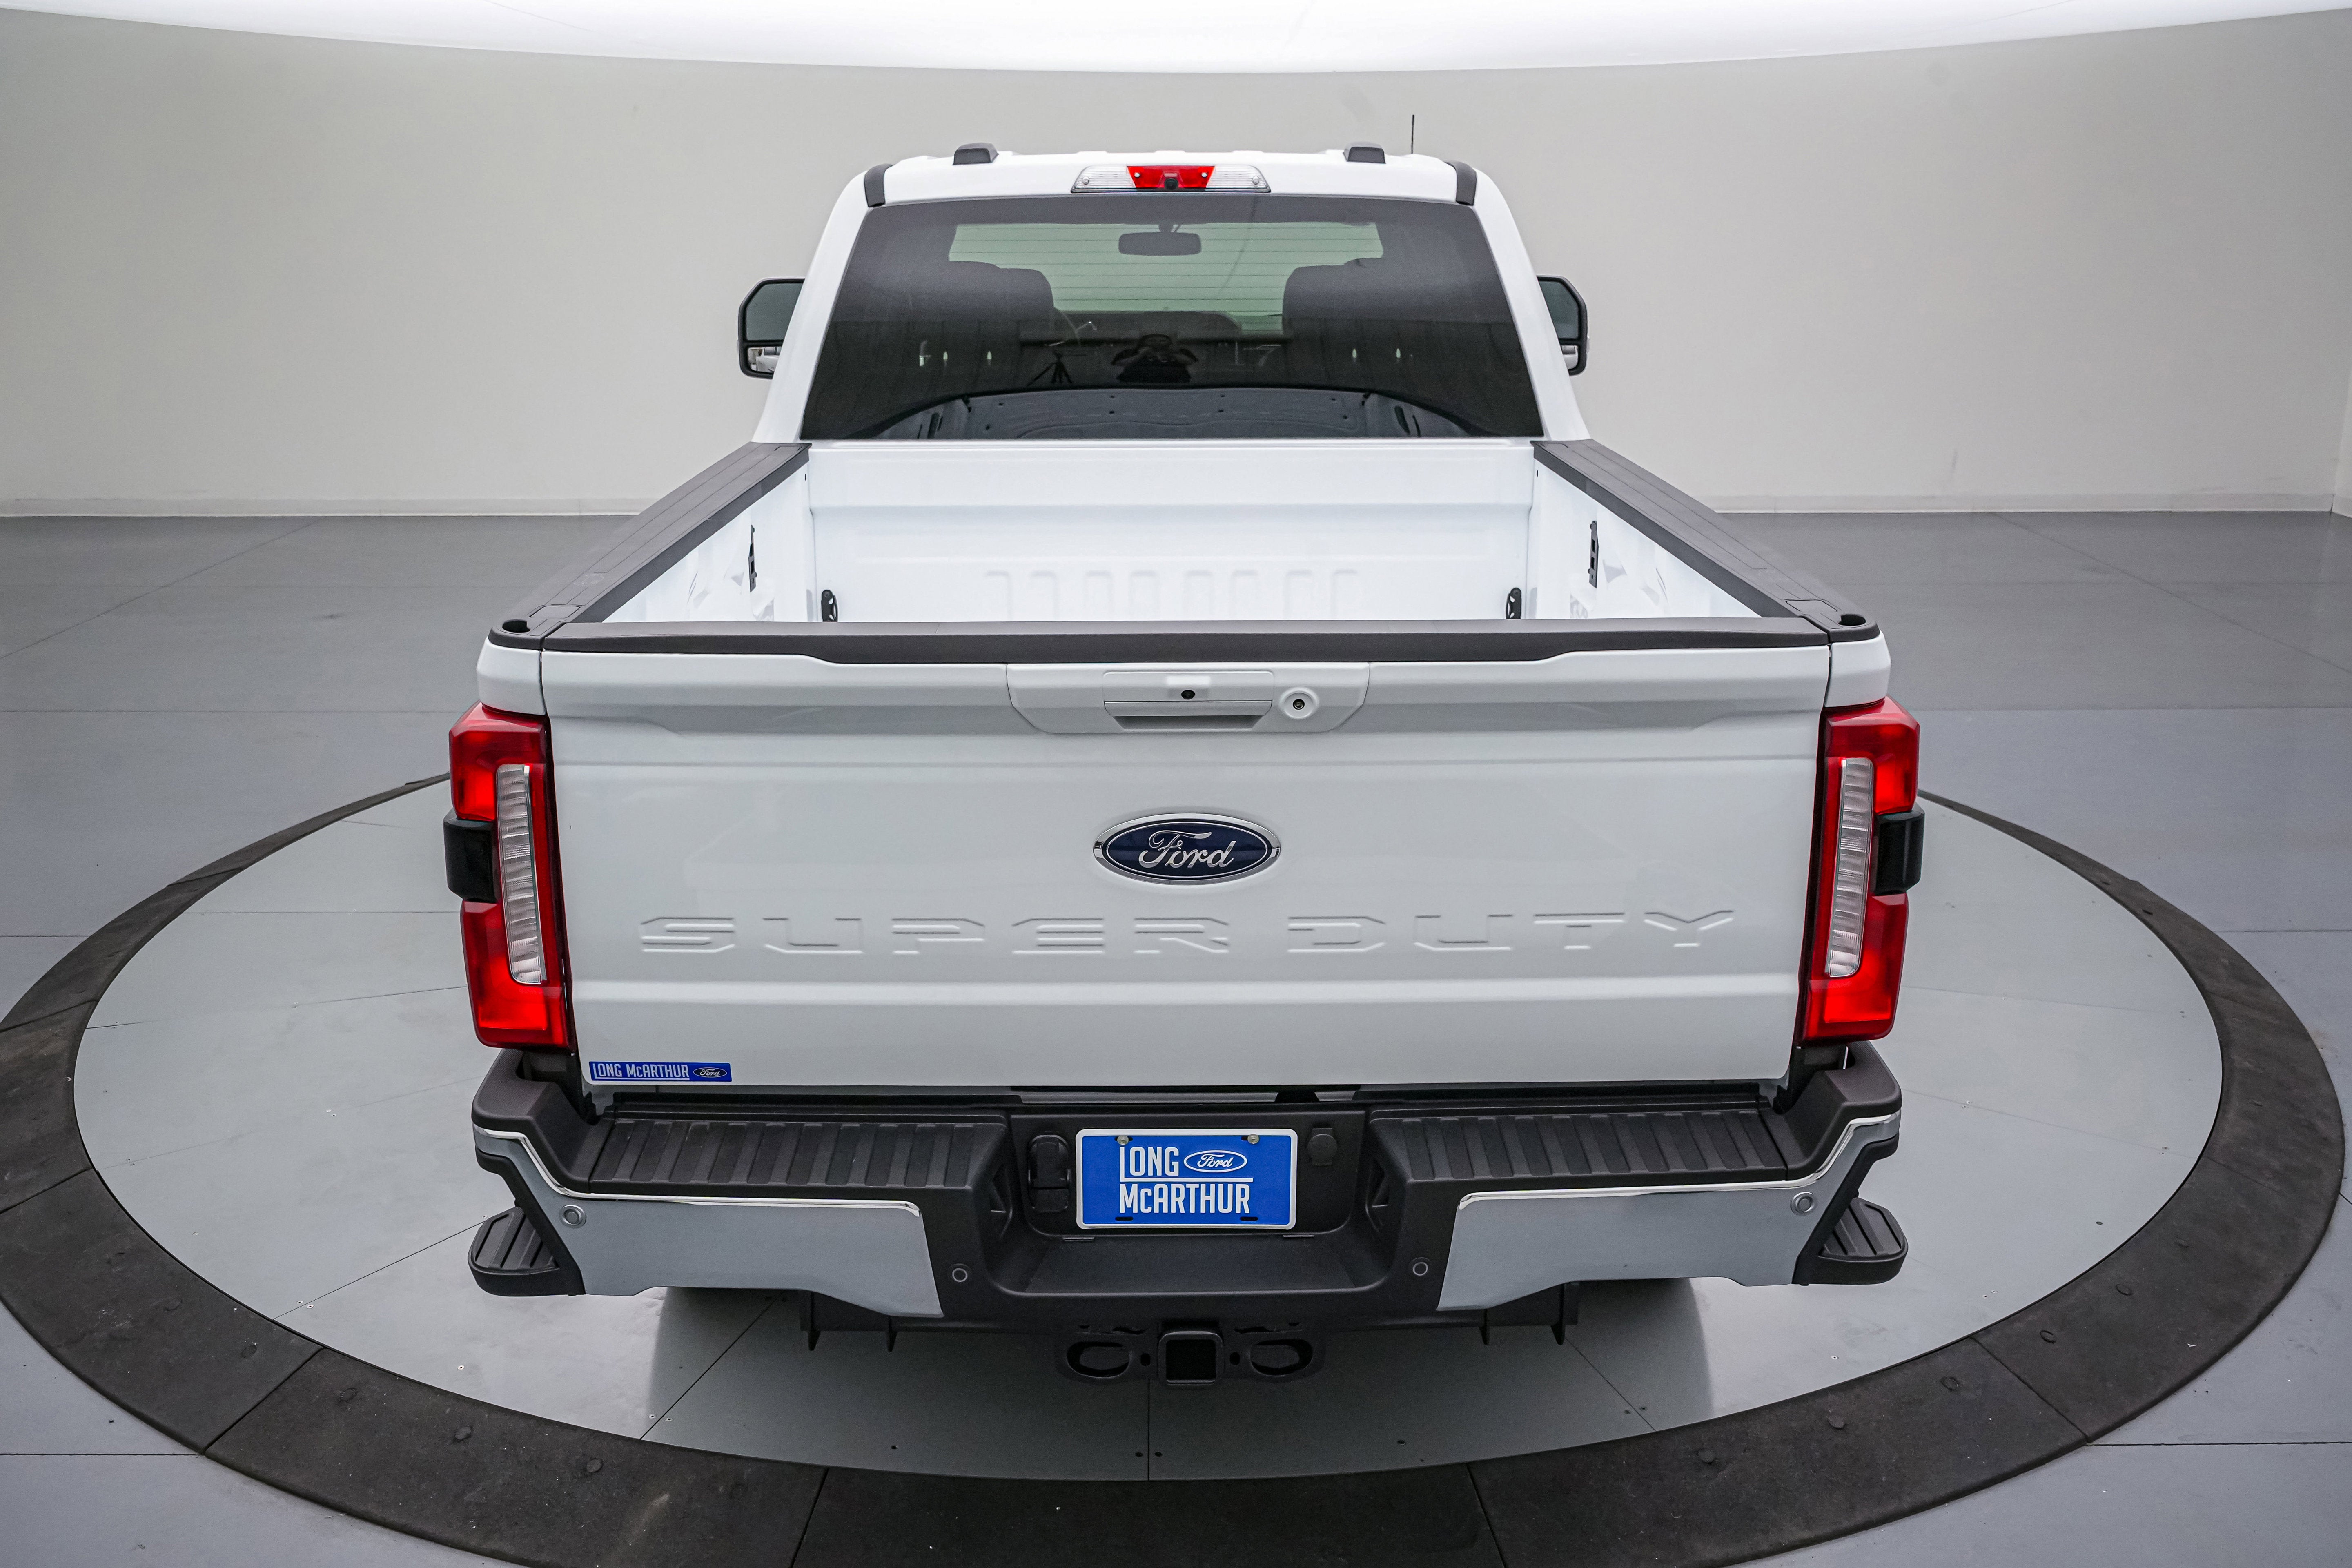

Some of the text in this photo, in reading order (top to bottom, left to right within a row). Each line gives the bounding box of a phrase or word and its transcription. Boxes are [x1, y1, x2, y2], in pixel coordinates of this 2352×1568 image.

[1138, 830, 1236, 869] Ford
[640, 910, 1735, 954] SUPER DUTY
[592, 1063, 690, 1078] LONG McARTHUR
[699, 1068, 721, 1077] Ford
[1120, 1146, 1179, 1181] LONG
[1197, 1153, 1233, 1168] Ford
[1120, 1184, 1250, 1214] McARTHUR
